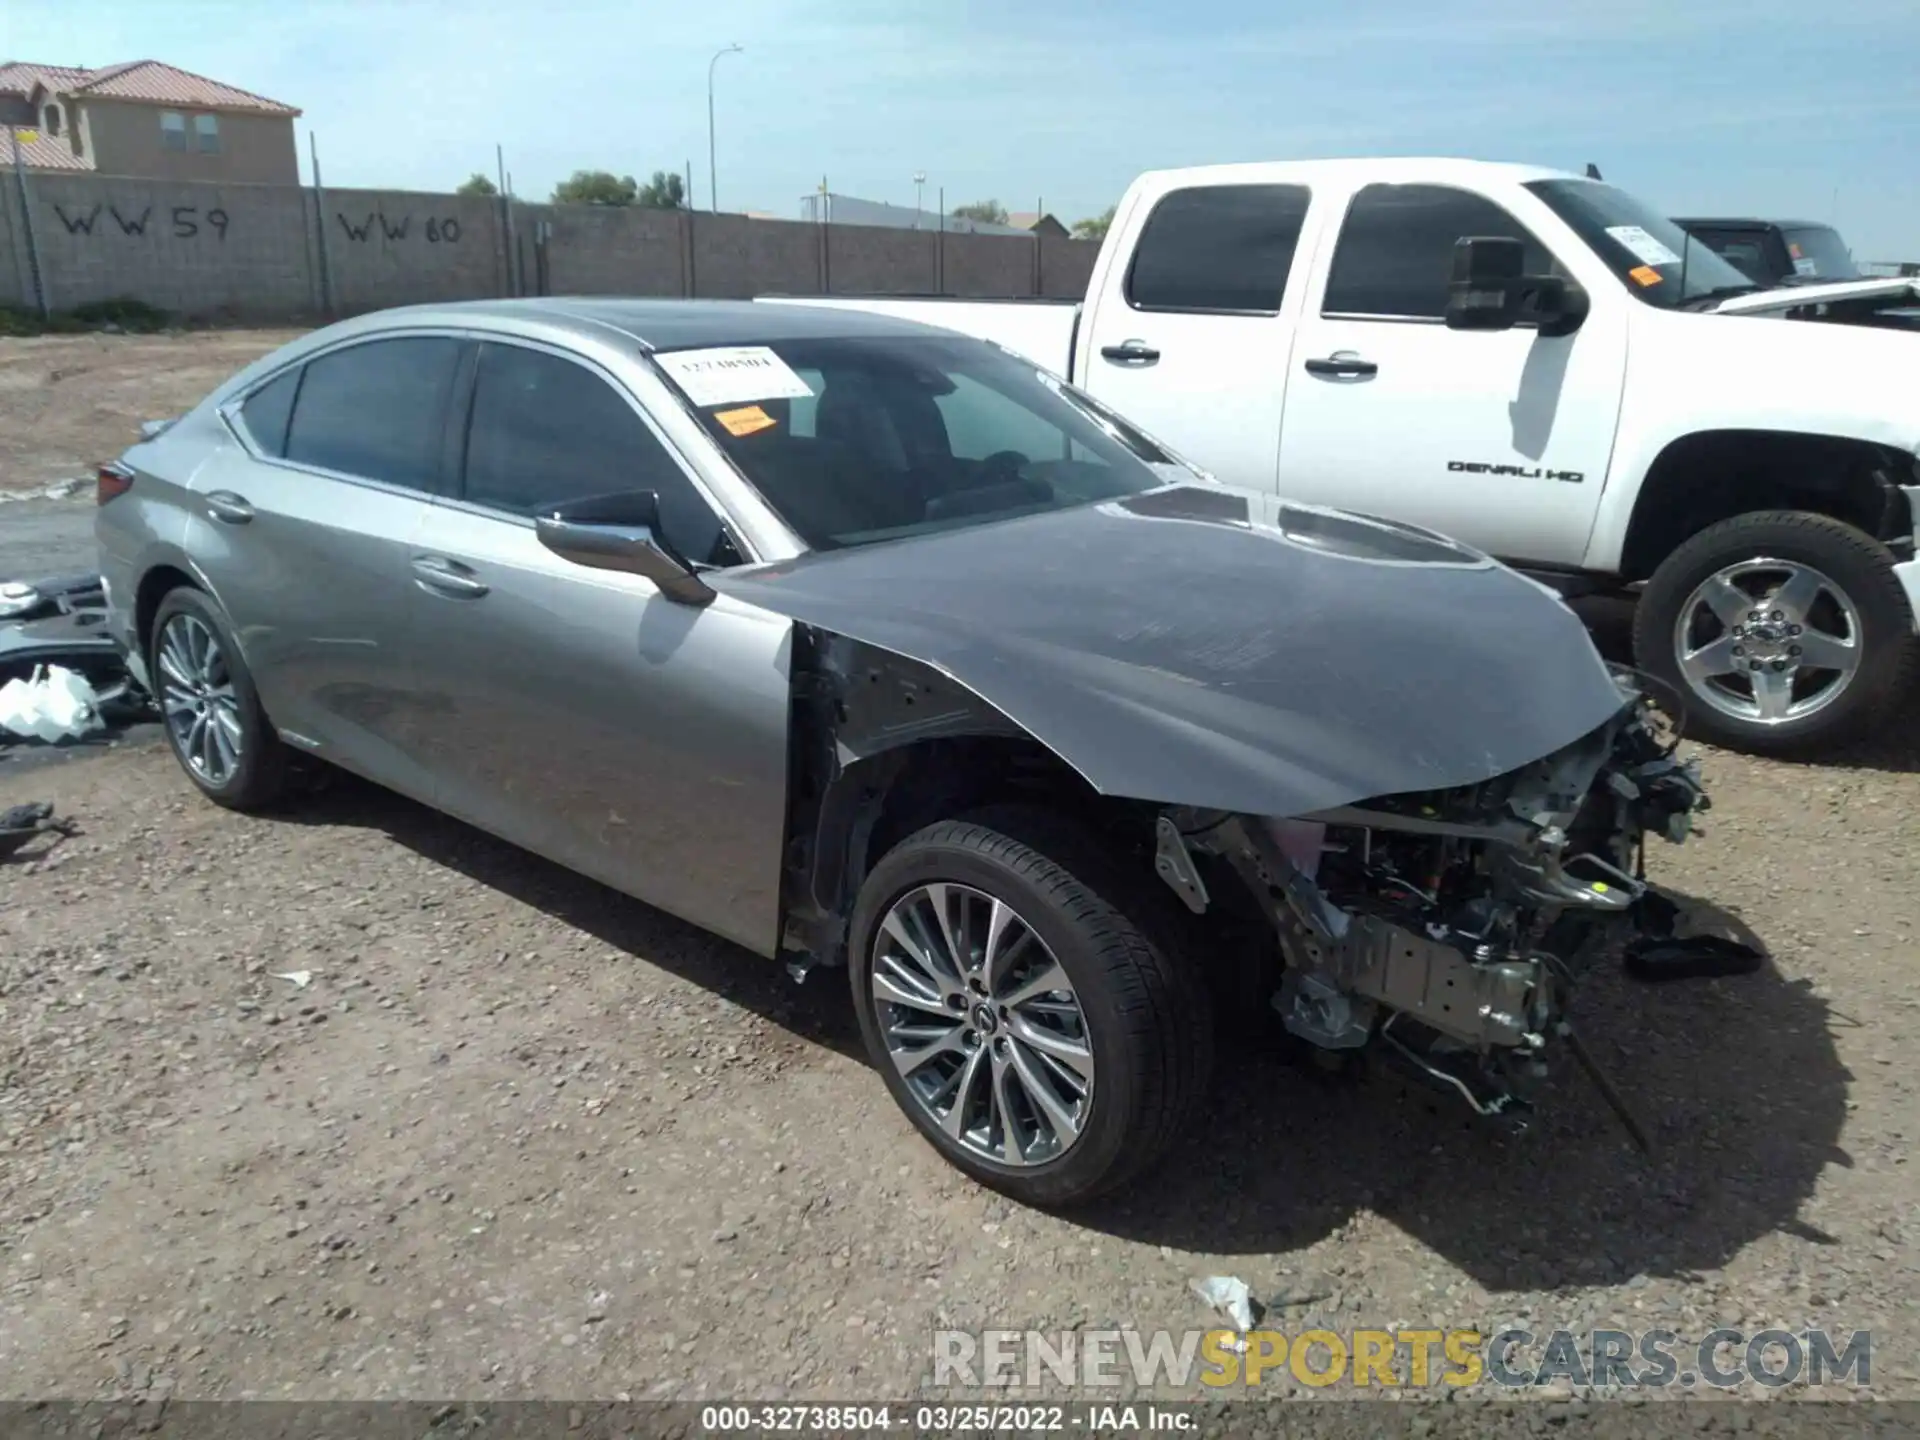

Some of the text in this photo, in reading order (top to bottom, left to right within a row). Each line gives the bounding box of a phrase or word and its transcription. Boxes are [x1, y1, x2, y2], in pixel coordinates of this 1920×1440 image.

[172, 207, 230, 241] 59
[425, 217, 461, 244] 60
[1447, 460, 1585, 483] DENALI HD
